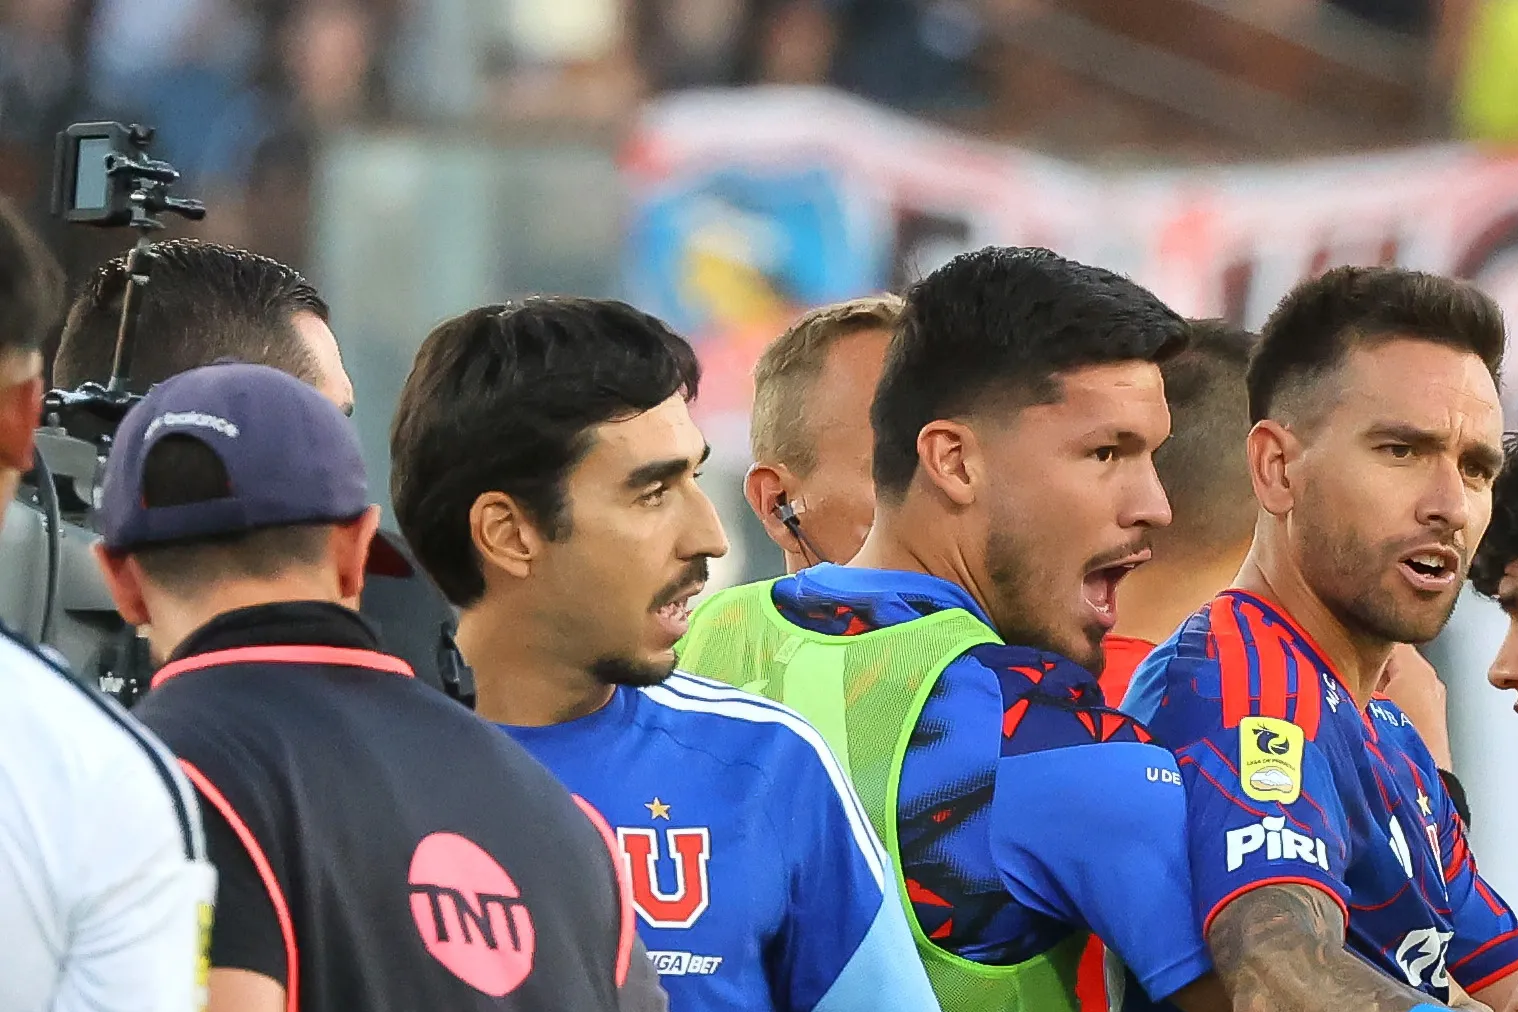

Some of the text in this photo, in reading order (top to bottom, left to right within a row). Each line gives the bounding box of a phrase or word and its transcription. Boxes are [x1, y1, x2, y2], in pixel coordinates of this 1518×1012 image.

[1146, 767, 1159, 781] U
[617, 827, 711, 929] U
[408, 883, 522, 953] TNT
[687, 956, 723, 975] BET
